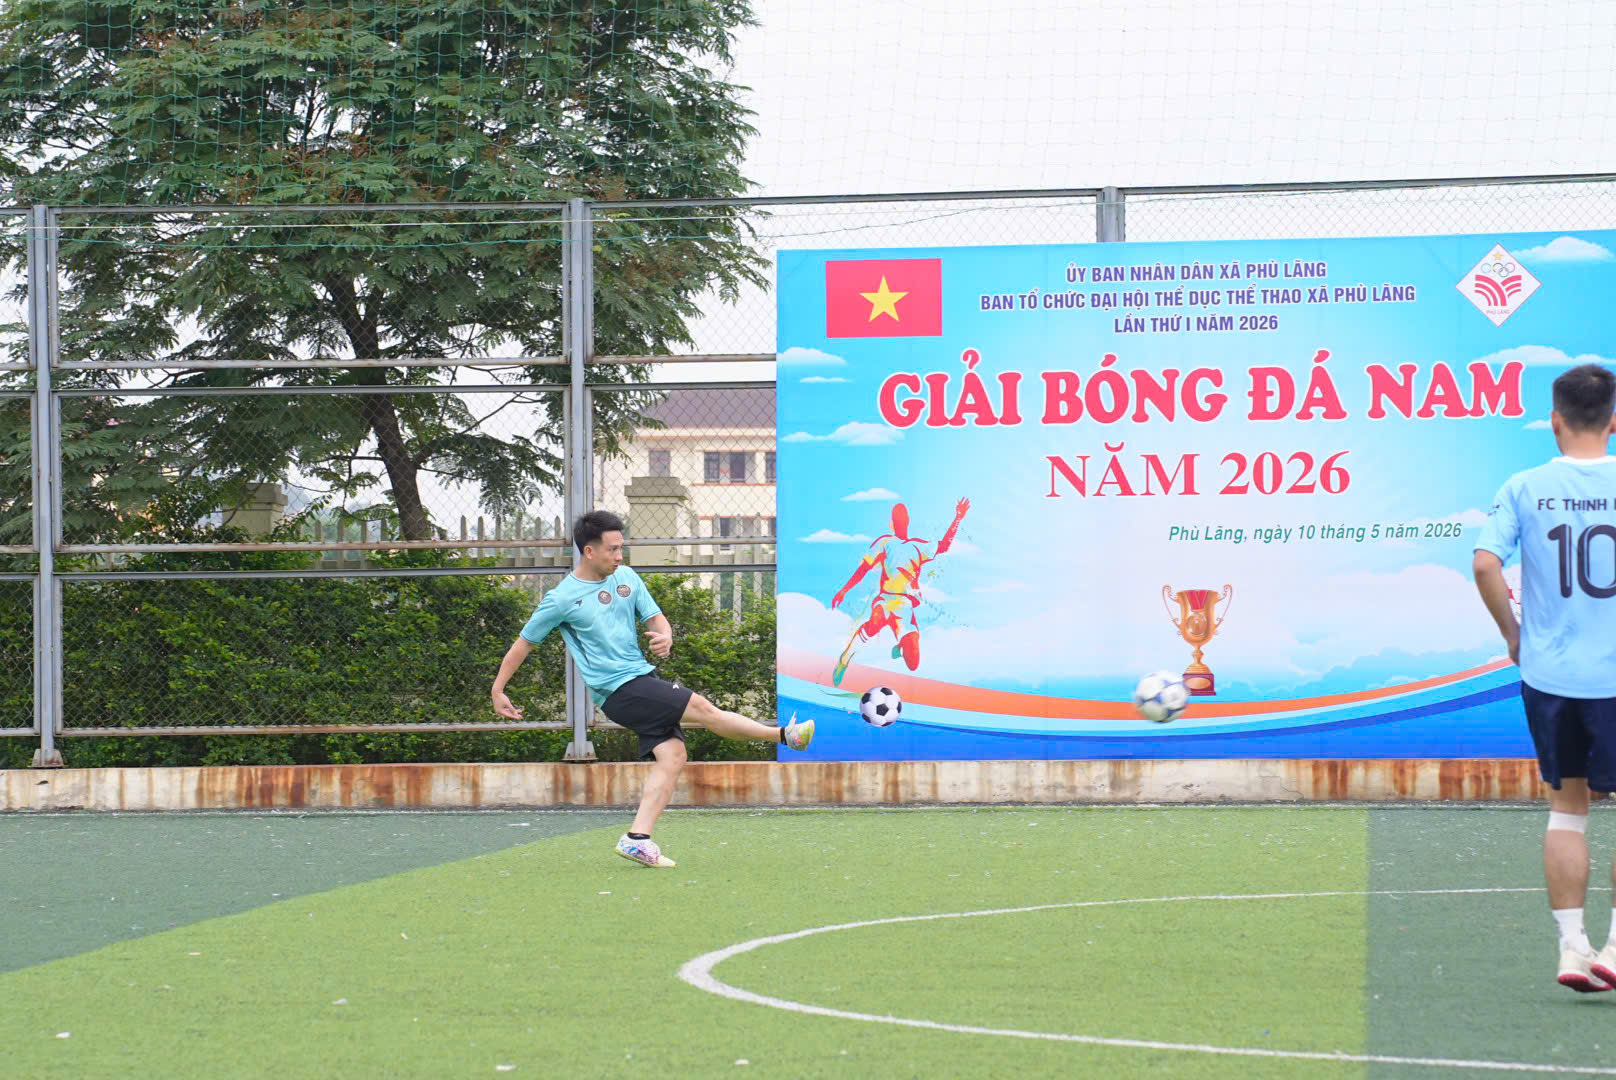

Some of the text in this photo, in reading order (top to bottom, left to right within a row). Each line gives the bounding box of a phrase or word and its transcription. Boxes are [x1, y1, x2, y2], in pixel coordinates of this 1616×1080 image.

[1067, 260, 1326, 282] ỦY BAN NHÂN DÂN XÃ PHÙ LÃNG
[981, 283, 1415, 311] BAN TỔ CHỨC ĐẠI HỘI THỂ DỤC THỂ THAO XÃ PHÙ LÃNG
[1115, 313, 1278, 333] LẦN THỨ I NĂM 2026
[879, 349, 1524, 428] GIẢI BÓNG ĐÁ NAM
[1046, 441, 1350, 498] NĂM 2026
[1537, 498, 1555, 511] FC
[1562, 498, 1607, 511] THINH
[1169, 525, 1200, 540] Phù
[1254, 524, 1292, 544] ngày
[1299, 525, 1316, 540] 10
[1320, 523, 1366, 543] tháng
[1371, 524, 1380, 538] 5
[1385, 523, 1419, 538] năm
[1424, 523, 1462, 538] 2026
[1547, 524, 1616, 599] 10
